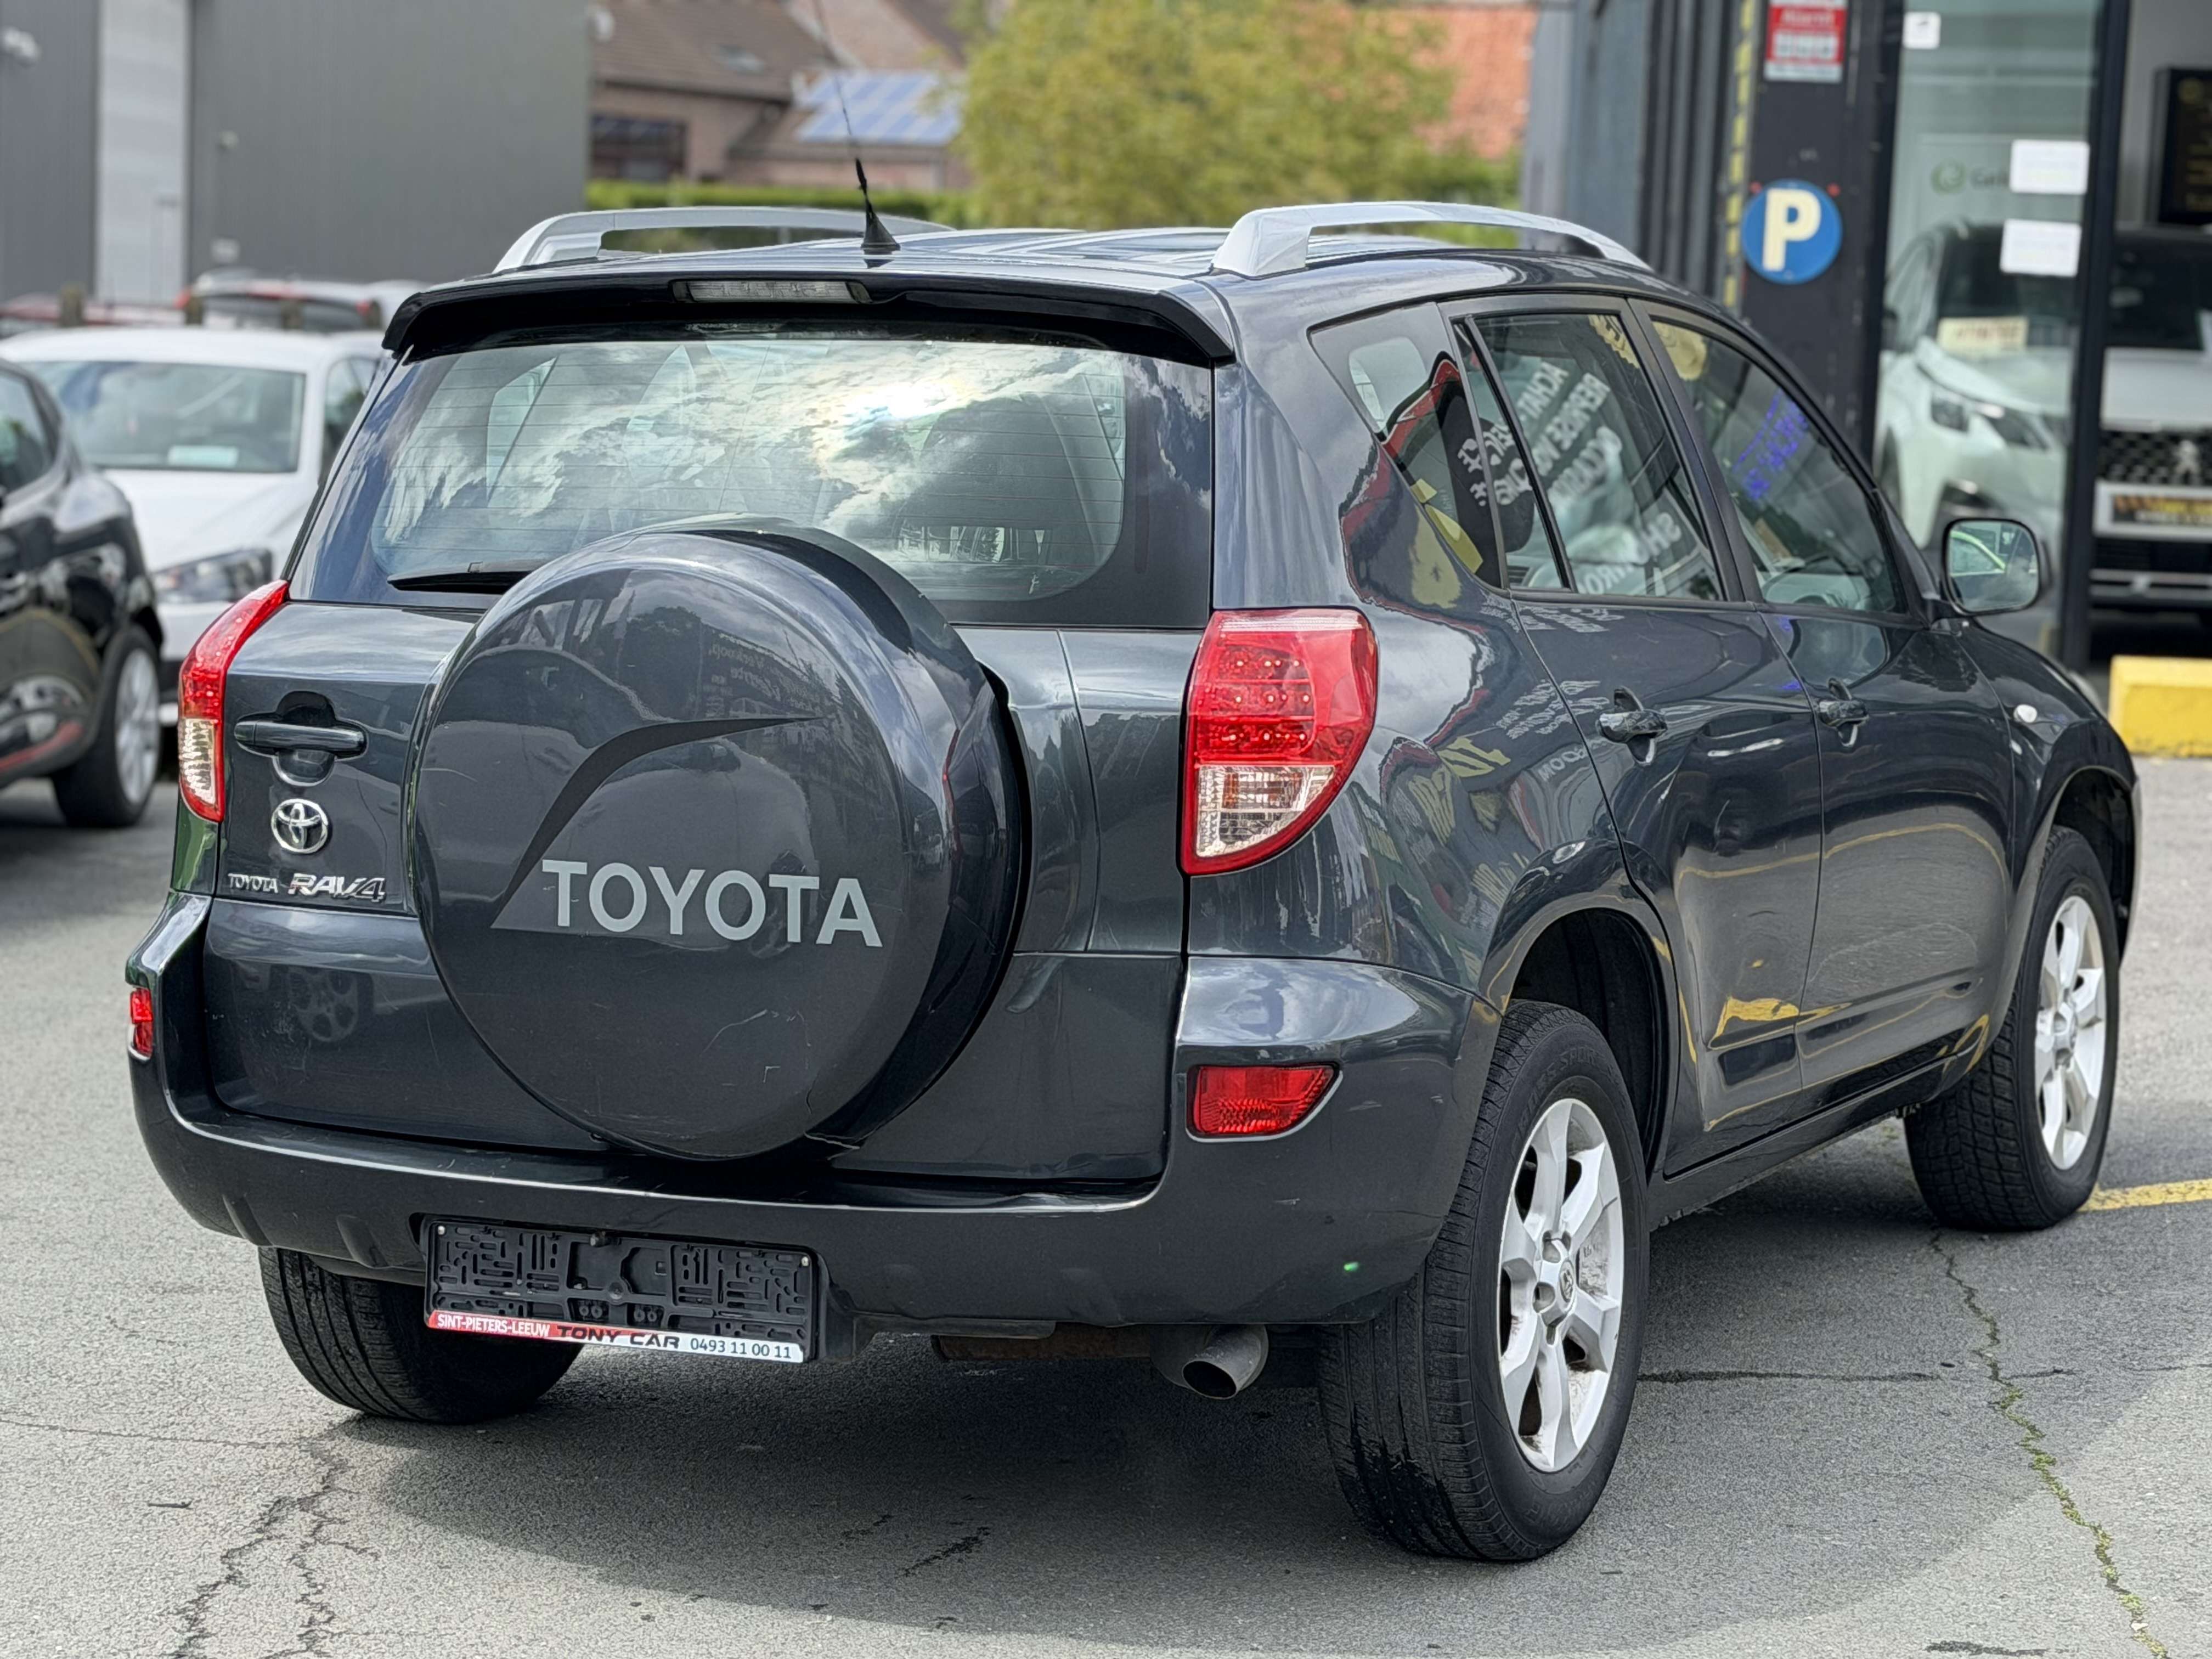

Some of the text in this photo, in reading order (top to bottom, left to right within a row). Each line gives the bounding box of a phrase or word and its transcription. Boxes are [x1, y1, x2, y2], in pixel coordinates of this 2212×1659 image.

[1762, 188, 1821, 272] P
[227, 872, 386, 903] TOYOTA RAV4
[542, 859, 883, 947] TOYOTA
[437, 1313, 792, 1359] SINT-PIETERS-LEEUW TONY CAR 0493 11 00 11
